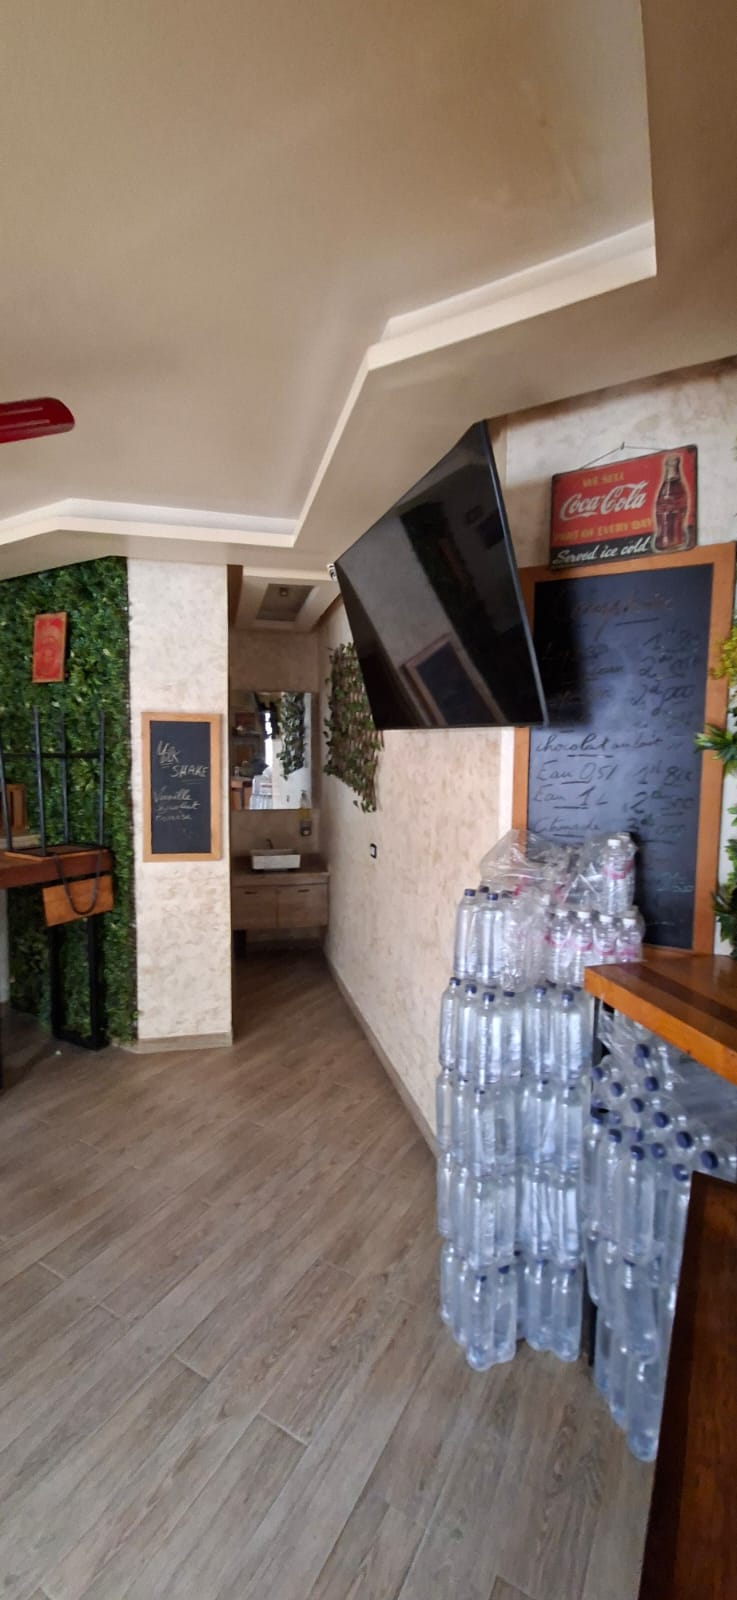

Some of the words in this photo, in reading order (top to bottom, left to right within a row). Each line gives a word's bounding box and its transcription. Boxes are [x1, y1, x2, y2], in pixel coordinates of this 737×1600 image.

[552, 546, 599, 564] Served
[600, 544, 616, 557] ice
[620, 536, 651, 554] cold
[170, 764, 209, 778] SHAKE
[536, 760, 573, 781] Eau
